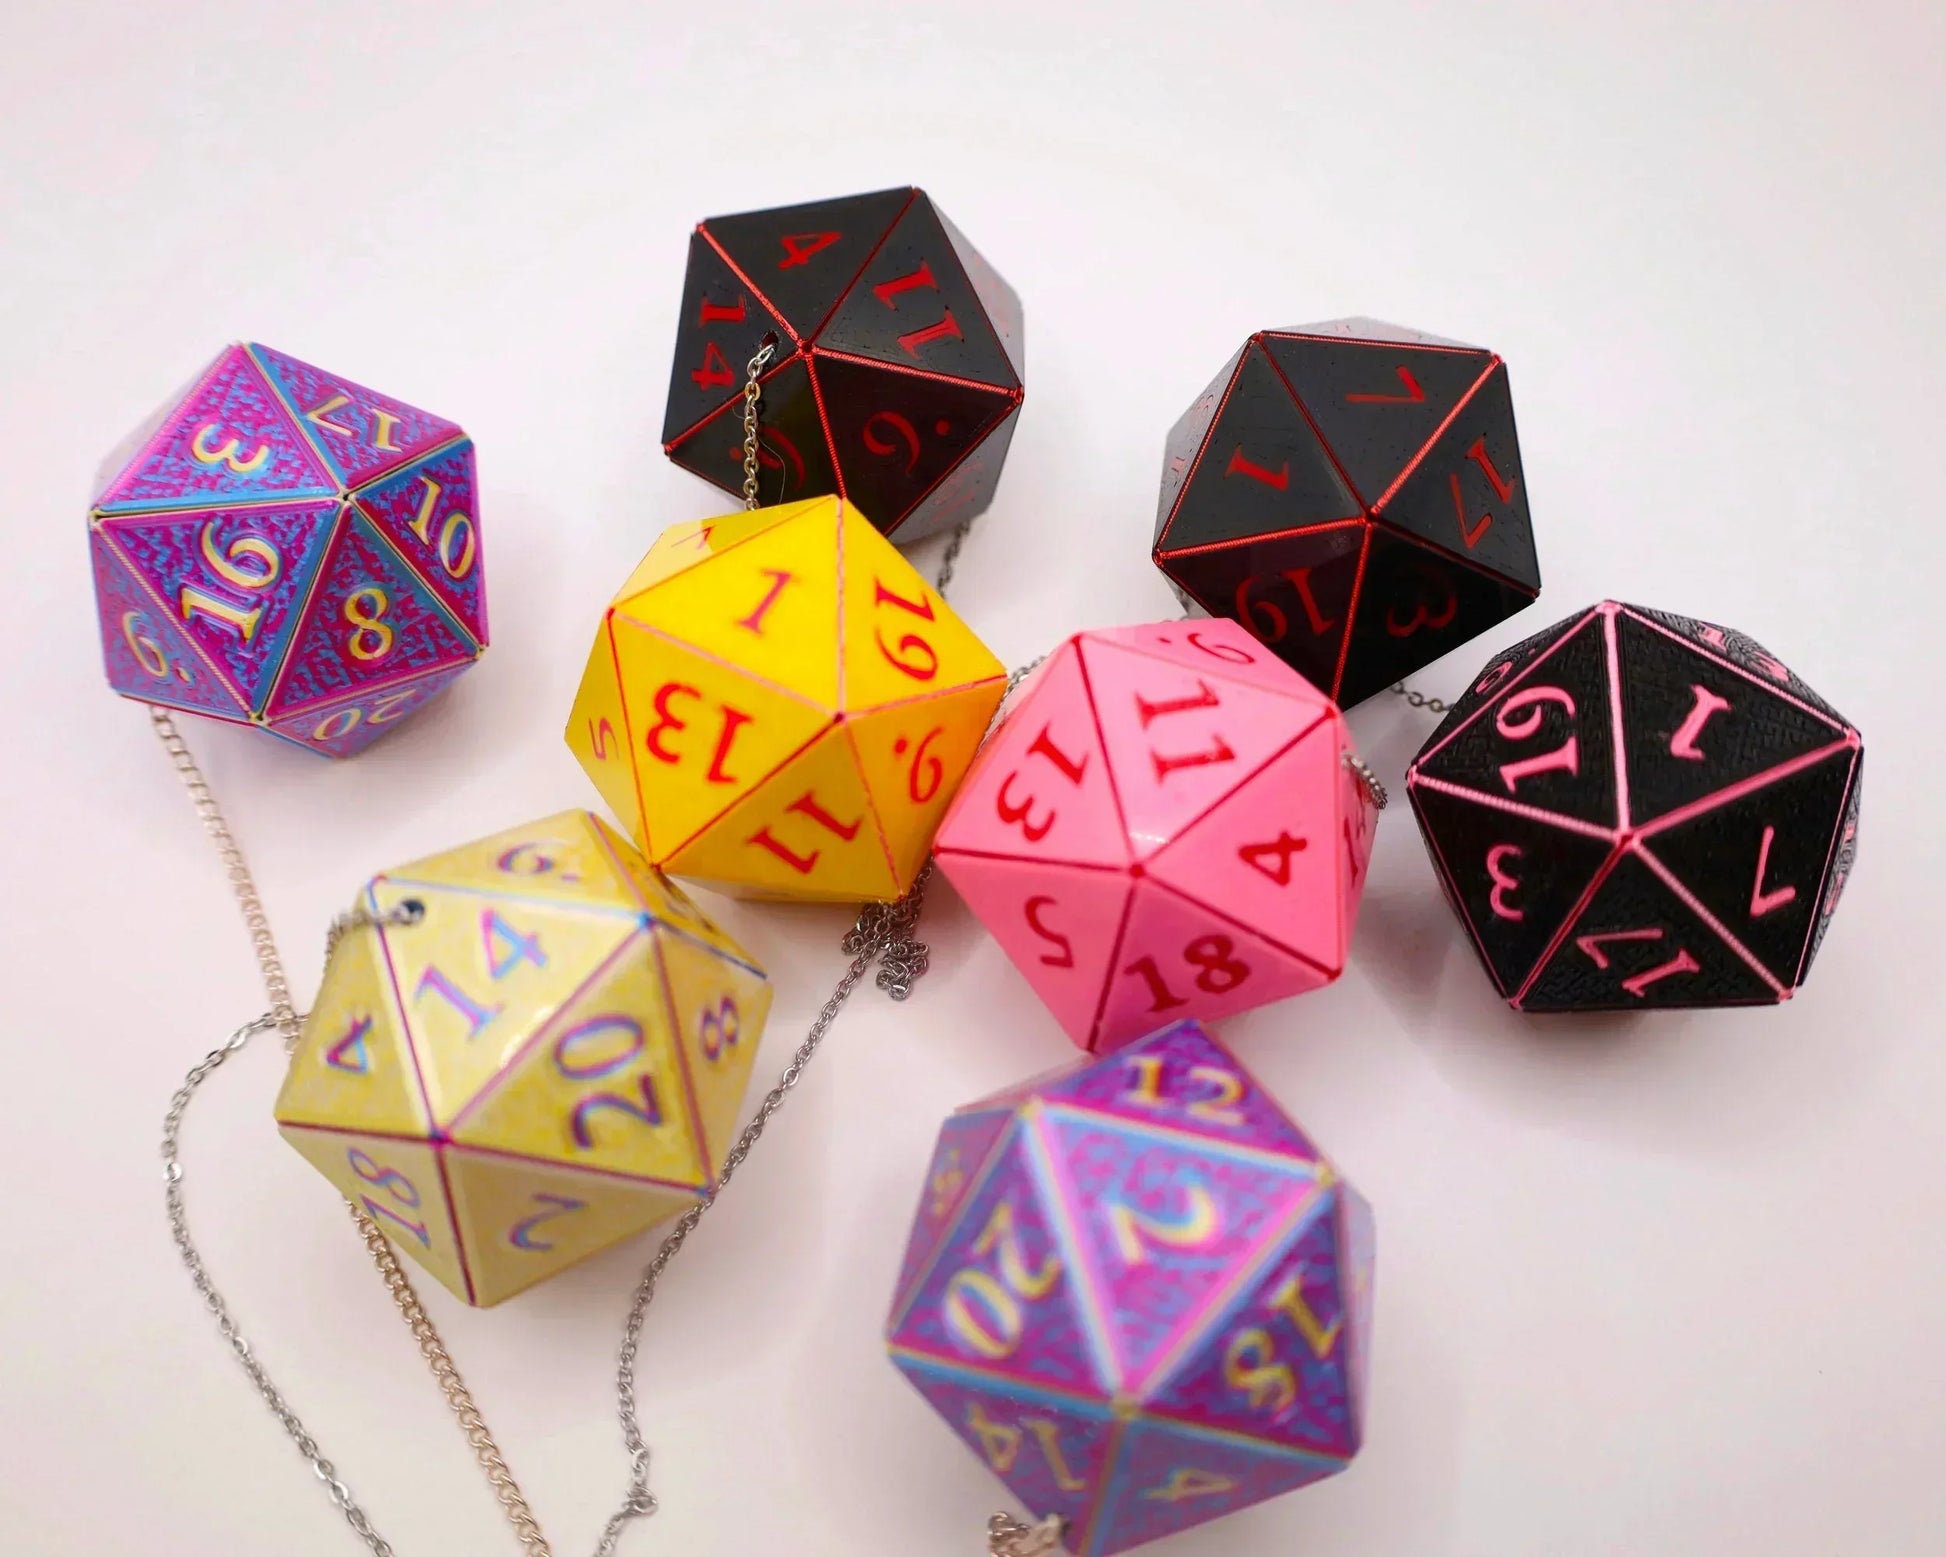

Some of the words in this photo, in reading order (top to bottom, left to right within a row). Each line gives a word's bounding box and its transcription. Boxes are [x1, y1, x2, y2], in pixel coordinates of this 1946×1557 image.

[778, 232, 841, 270] 4
[691, 295, 746, 391] 14
[873, 258, 964, 359] 11
[1346, 364, 1426, 402] 7
[191, 423, 268, 473] 3
[307, 395, 401, 452] 17
[1224, 444, 1290, 491] 1
[1451, 436, 1515, 549] 17
[408, 477, 476, 579] 10
[182, 522, 279, 644] 16
[734, 569, 796, 636] 1
[344, 588, 391, 660] 8
[875, 576, 939, 682] 19
[314, 690, 416, 741] 20
[646, 682, 754, 785] 13
[1134, 679, 1237, 784] 11
[1671, 685, 1731, 759] 1
[997, 722, 1089, 842] 13
[748, 791, 862, 876] 11
[1238, 832, 1307, 887] 4
[1751, 827, 1796, 918] 7
[1487, 844, 1524, 920] 3
[1024, 895, 1075, 969] 5
[1576, 929, 1700, 996] 17
[414, 908, 547, 1041] 14
[1124, 935, 1252, 1014] 18
[327, 1014, 373, 1074] 4
[700, 995, 740, 1063] 8
[553, 1014, 664, 1150] 20
[1124, 1056, 1246, 1127] 12
[348, 1149, 431, 1249] 18
[510, 1193, 587, 1251] 2
[1107, 1184, 1220, 1266] 2
[943, 1204, 1060, 1358] 20
[1225, 1275, 1342, 1416] 18
[968, 1403, 1084, 1491] 14
[1148, 1469, 1238, 1501] 4
